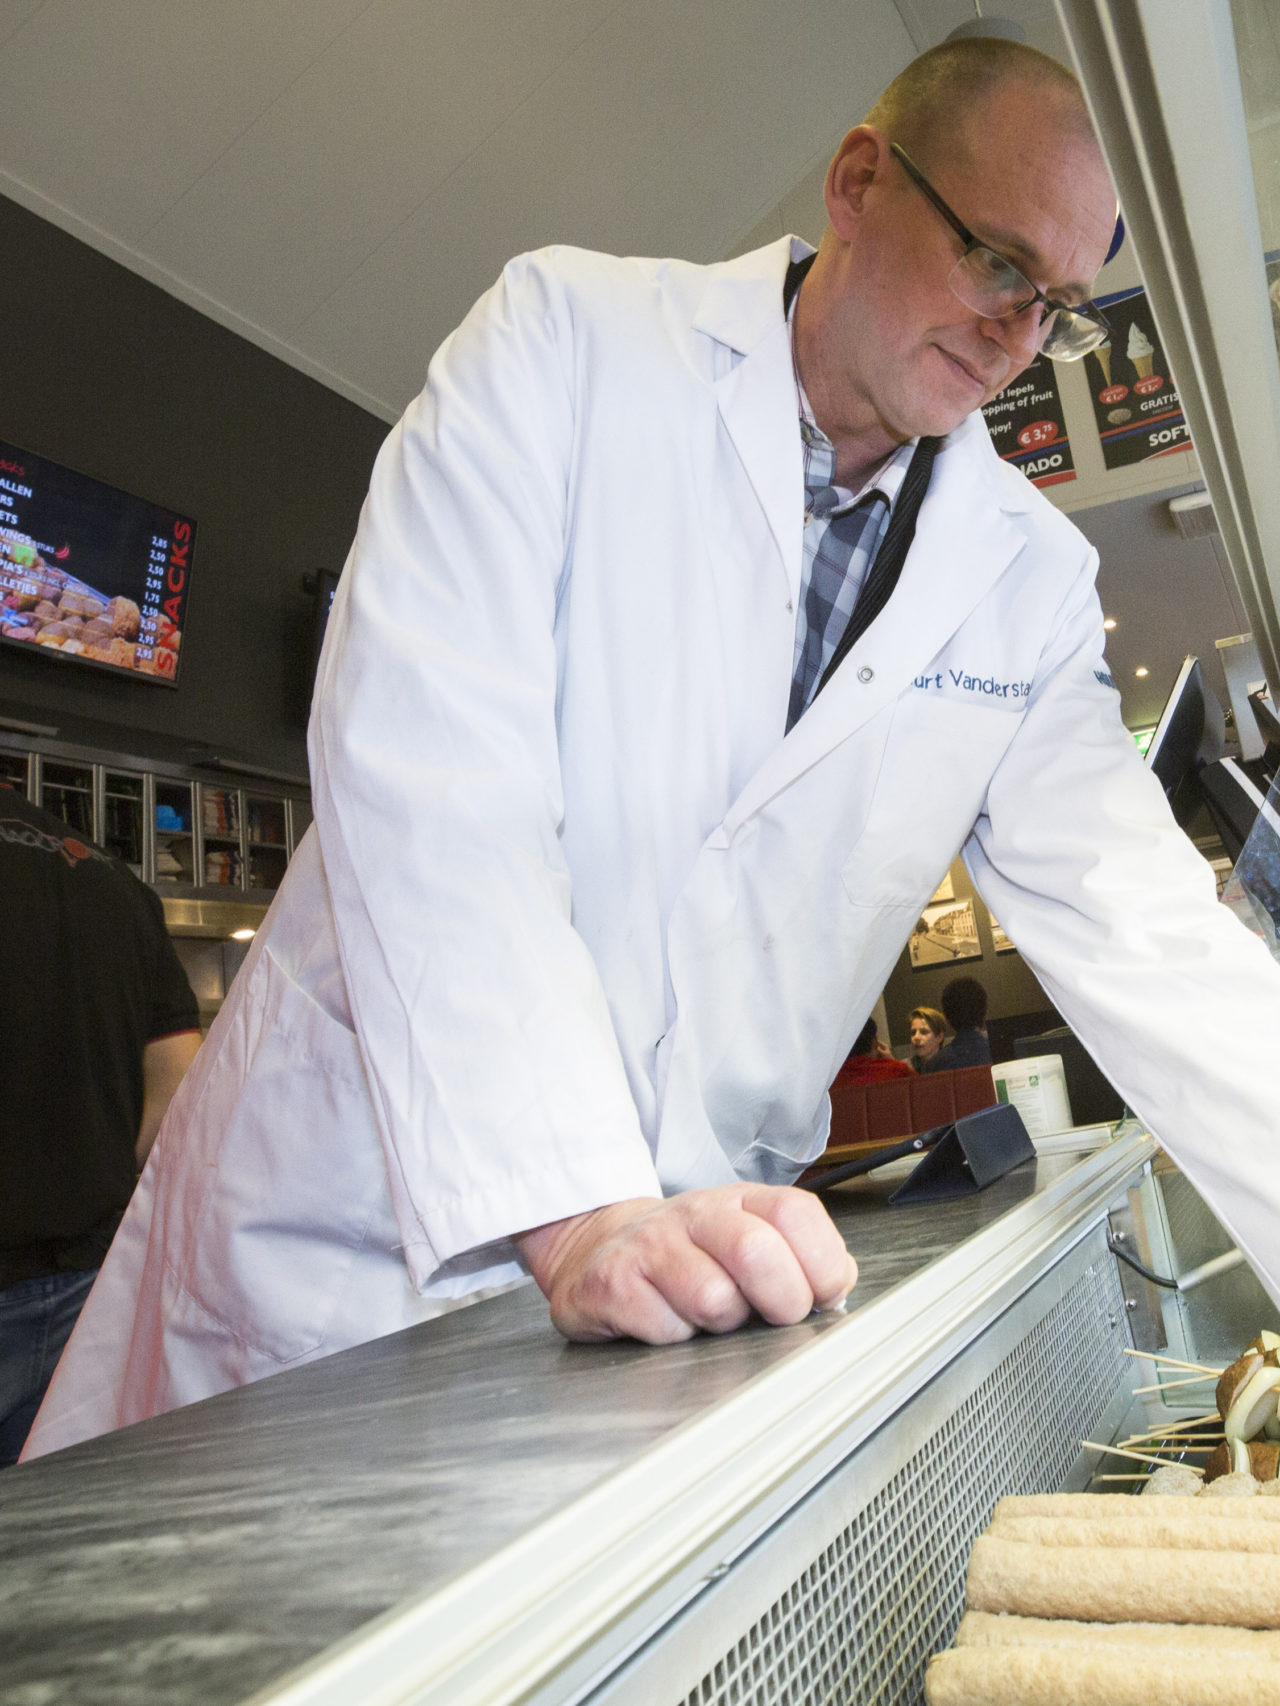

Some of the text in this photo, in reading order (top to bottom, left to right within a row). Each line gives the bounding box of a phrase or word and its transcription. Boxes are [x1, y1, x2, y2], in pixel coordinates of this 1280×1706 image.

[1007, 383, 1035, 397] lepels
[1017, 396, 1028, 407] of
[1030, 390, 1053, 405] fruit
[1140, 391, 1180, 411] GRATIS
[146, 578, 162, 590] 2,95
[156, 520, 191, 672] SNACKS
[910, 672, 943, 690] urt
